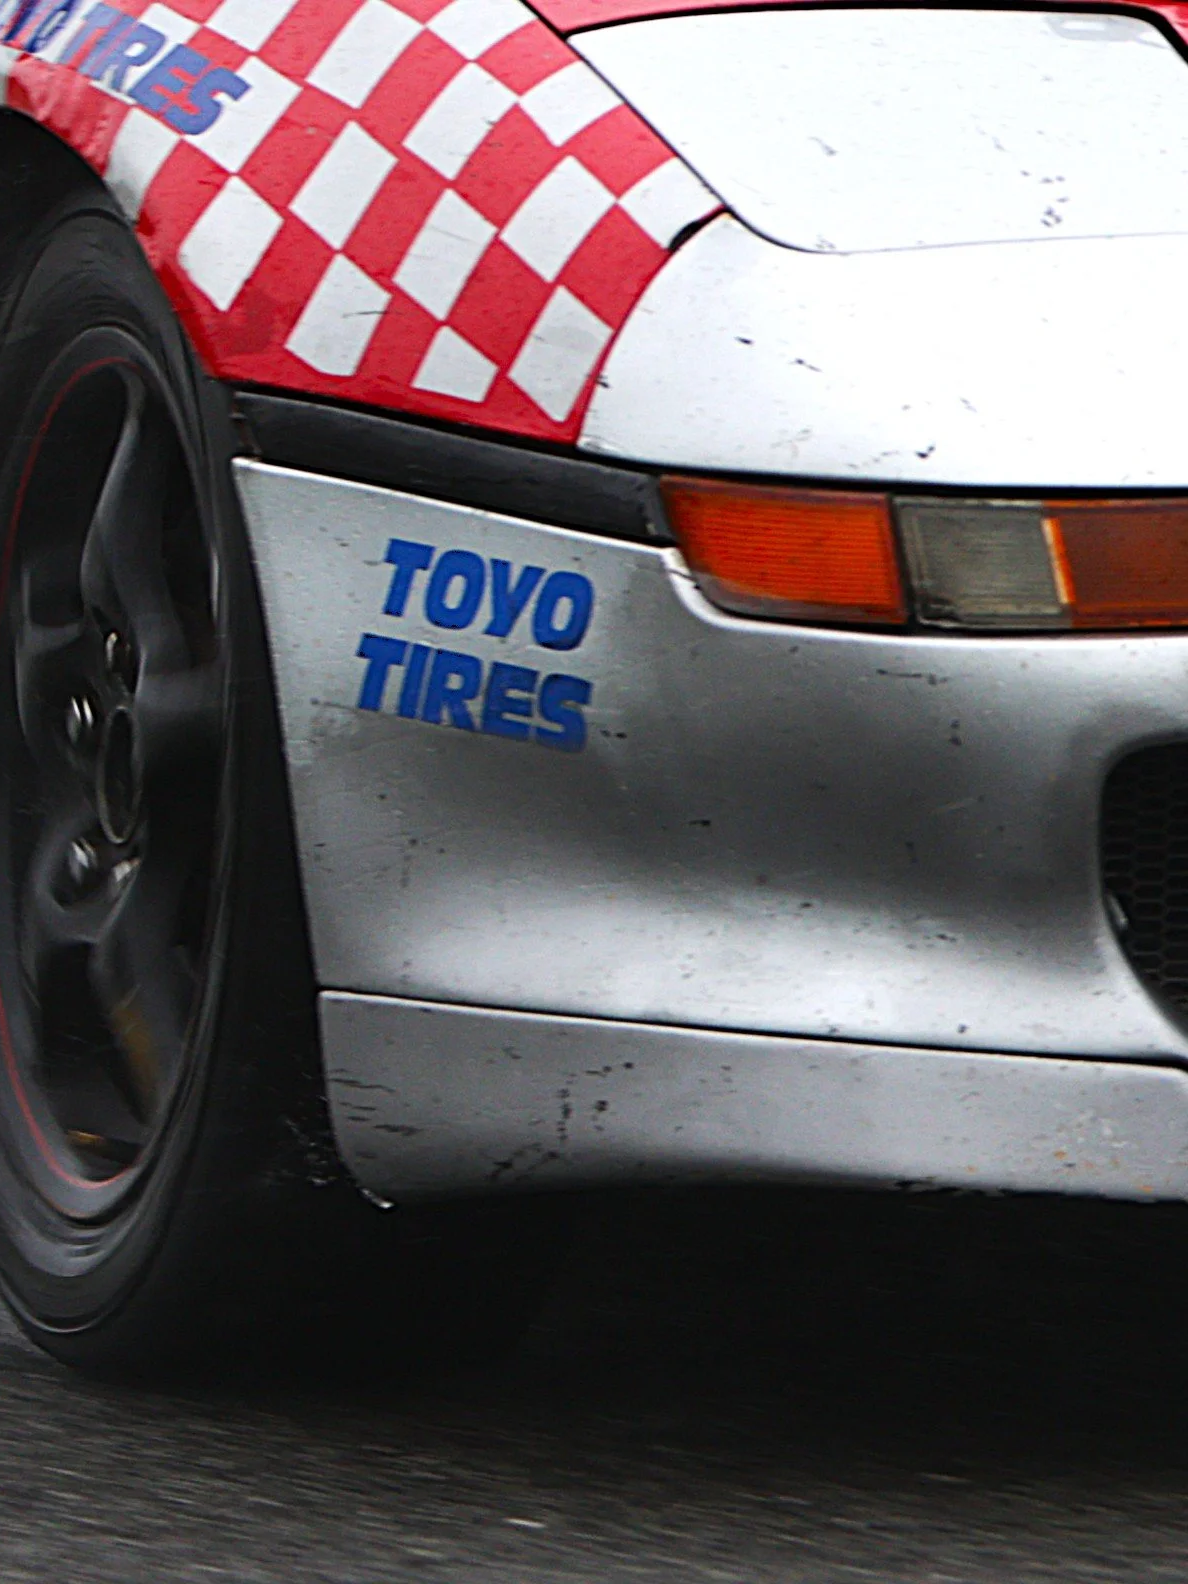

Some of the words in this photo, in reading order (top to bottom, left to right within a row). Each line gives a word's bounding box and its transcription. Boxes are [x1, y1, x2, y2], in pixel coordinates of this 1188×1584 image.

[59, 2, 252, 135] TIRES
[382, 538, 594, 651] TOYO
[356, 633, 593, 753] TIRES
